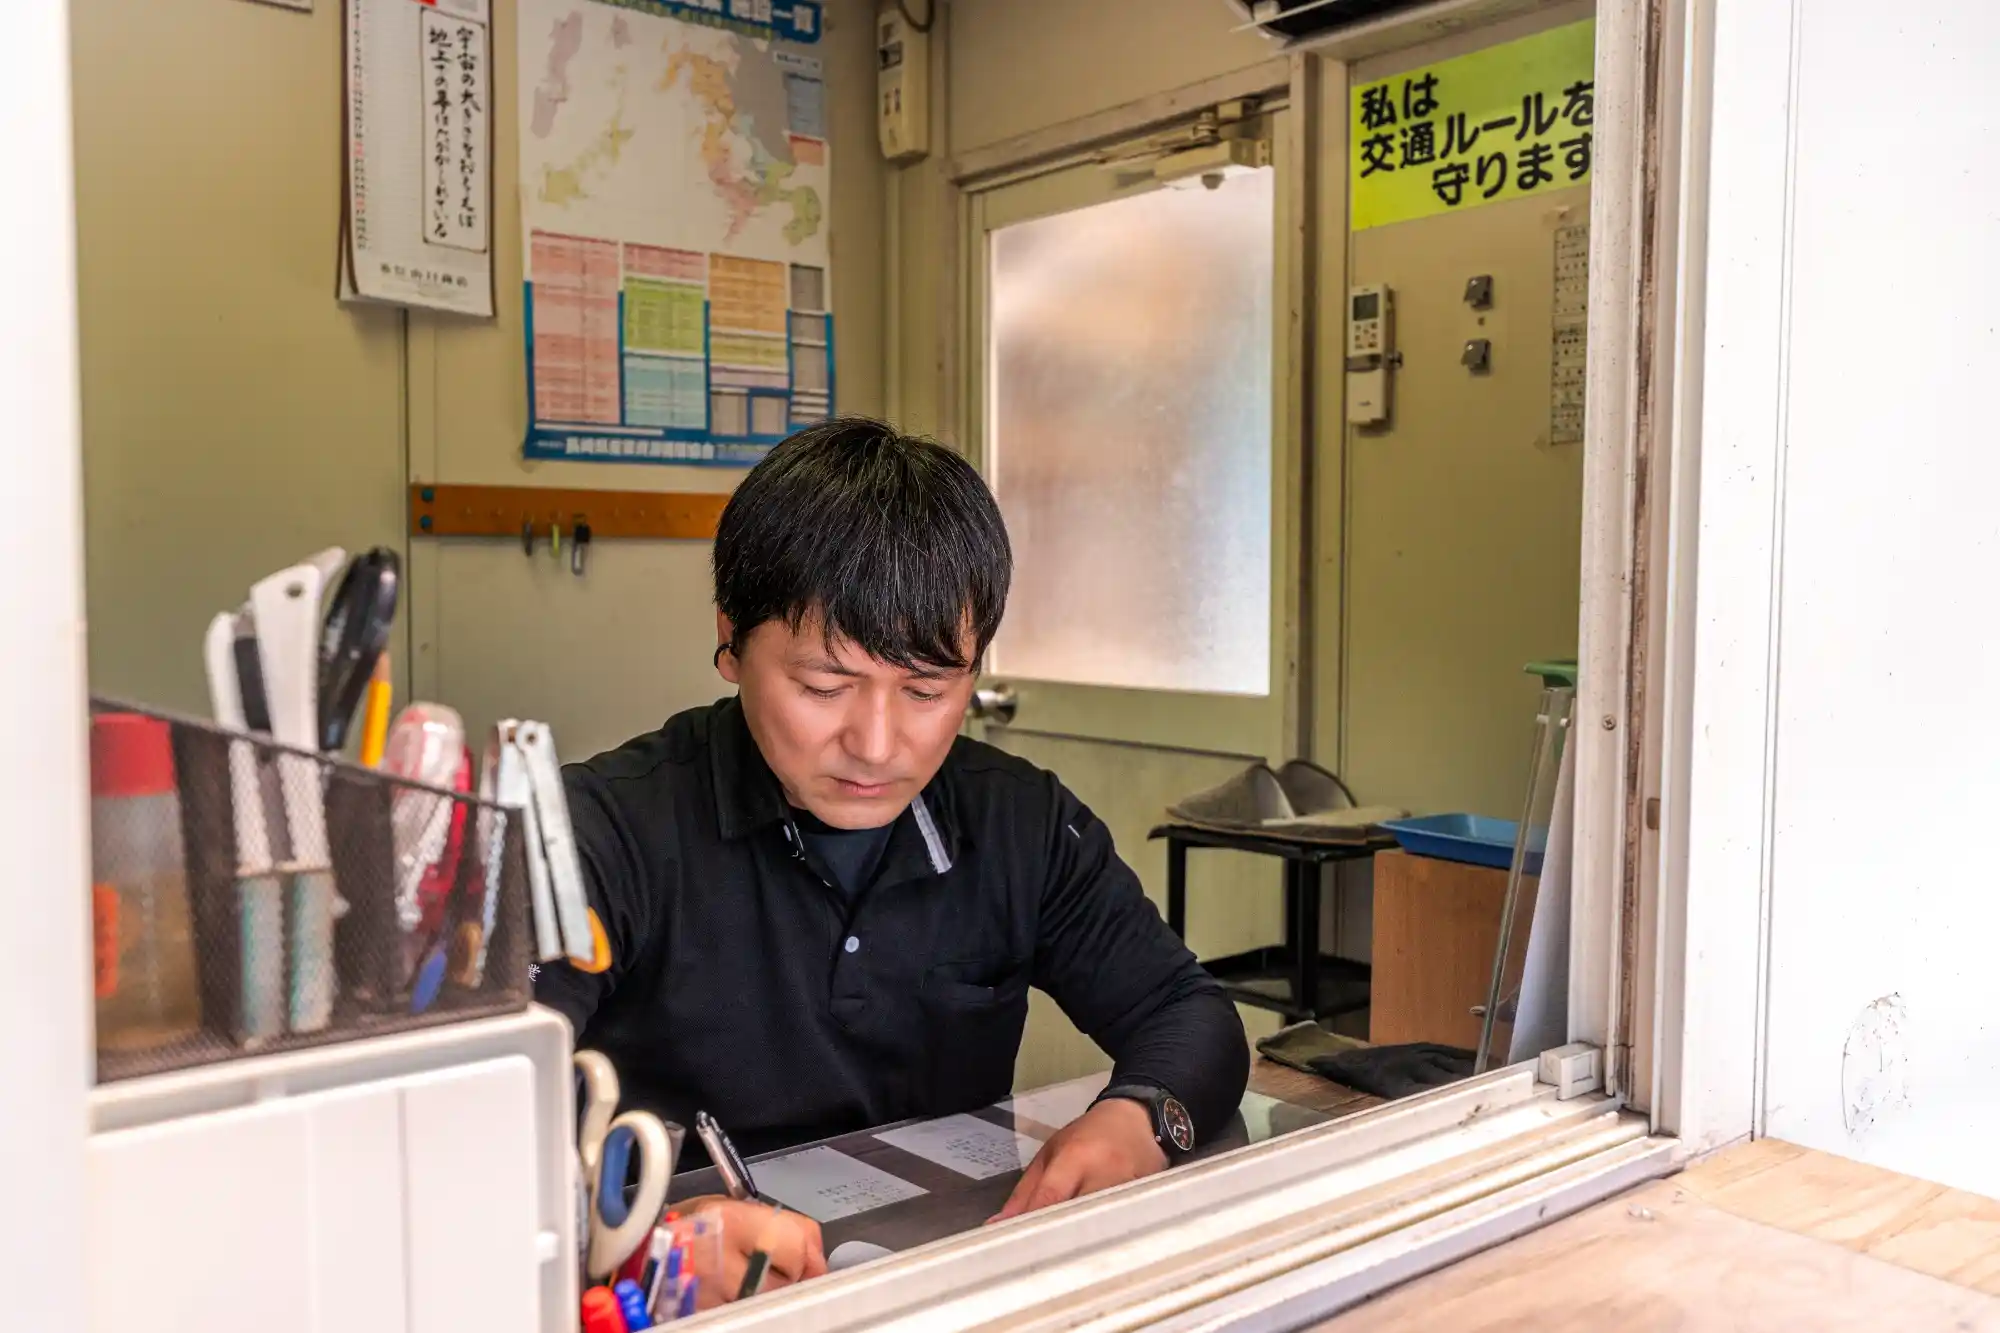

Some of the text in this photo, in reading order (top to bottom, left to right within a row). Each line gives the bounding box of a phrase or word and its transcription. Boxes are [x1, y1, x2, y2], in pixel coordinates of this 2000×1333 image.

[1360, 72, 1440, 131] 私は
[1360, 80, 1594, 178] 交通ルールを
[1432, 132, 1593, 206] 守ります
